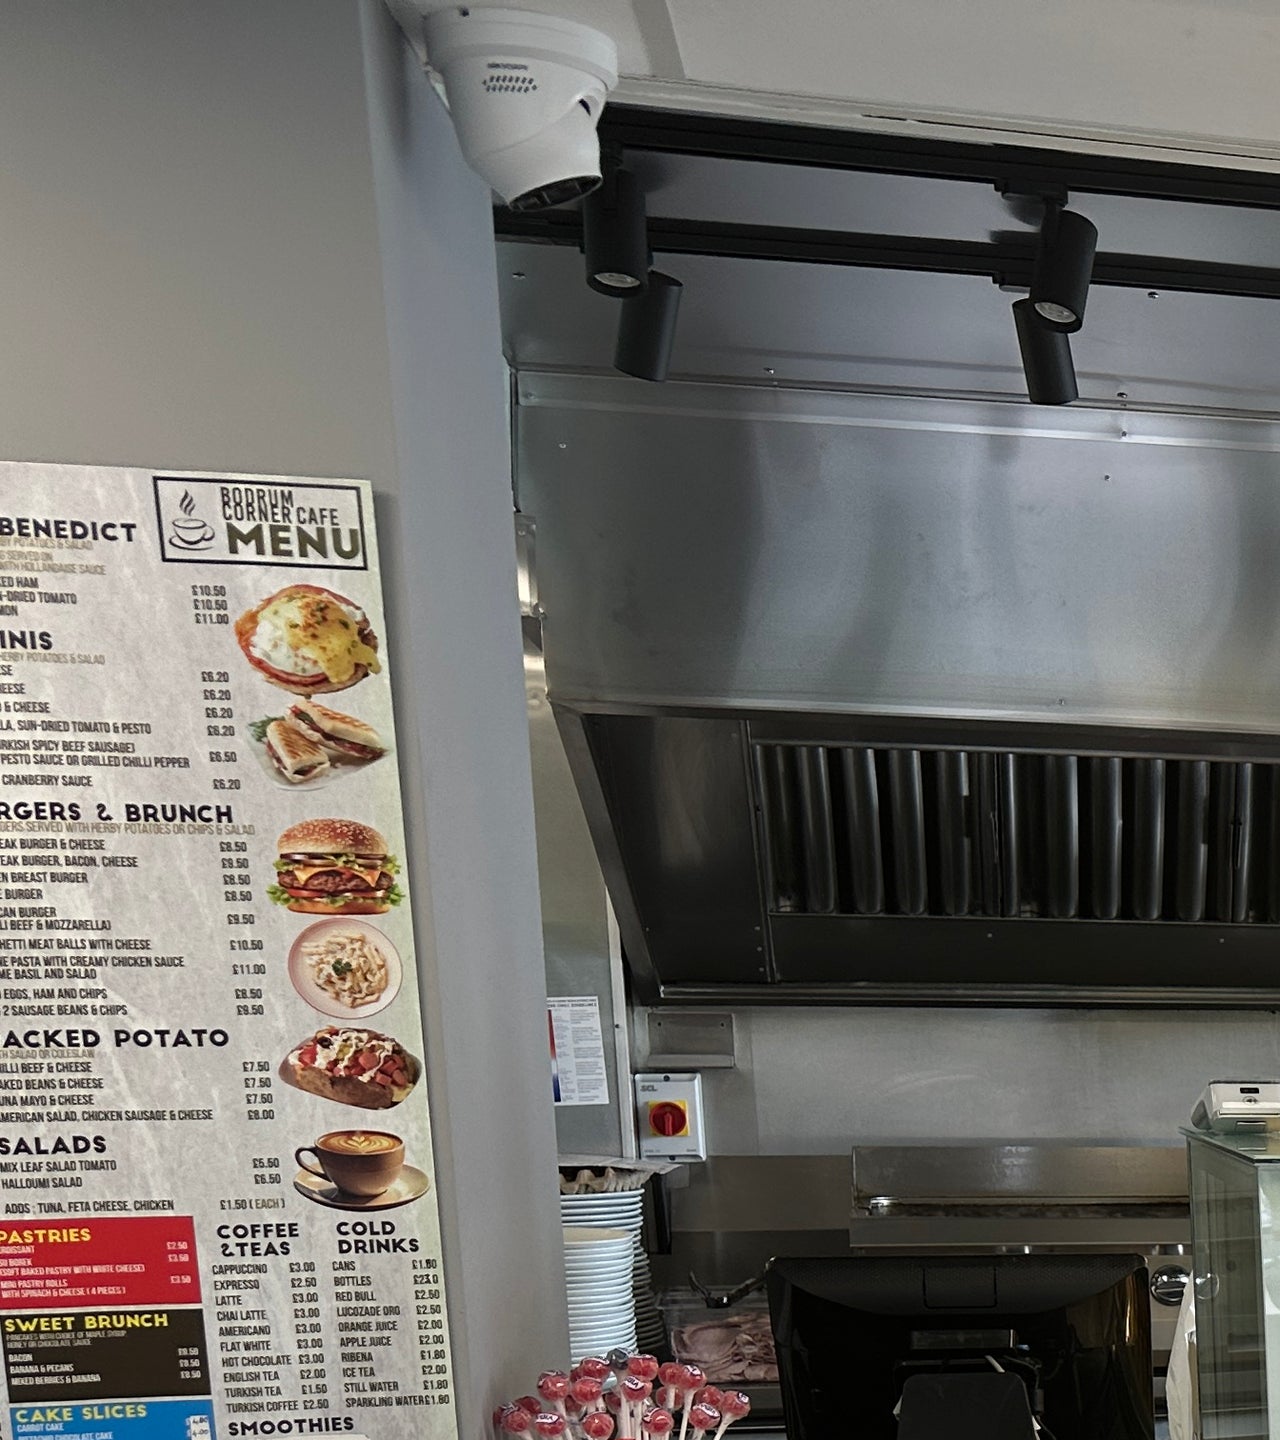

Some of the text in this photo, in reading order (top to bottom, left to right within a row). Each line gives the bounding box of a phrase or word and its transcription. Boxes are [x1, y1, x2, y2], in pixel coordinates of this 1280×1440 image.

[221, 486, 294, 508] BODRUM
[222, 503, 339, 526] CORNER CAFE
[0, 517, 137, 541] BENEDICT
[226, 522, 358, 559] MENU
[17, 578, 226, 596] HAM £10.50
[194, 600, 227, 611] £10.50
[13, 702, 50, 713] CHEESE
[121, 723, 151, 734] PESTO
[154, 757, 190, 768] PEPPER
[2, 775, 92, 786] CRANBERRY SAUCE
[125, 803, 233, 823] BRUNCH
[20, 839, 105, 850] BURGER CHEESE
[11, 872, 88, 884] BREAST BURGER
[28, 940, 263, 951] MEAT BALLS WITH CHEESE £10.50
[11, 956, 185, 967] PASTA CREAMY CHICKEN SAUCE
[114, 1028, 229, 1048] POTATO
[243, 1062, 270, 1072] £7.50
[82, 1110, 274, 1121] CHICKEN SAUSAGE CHEESE £8.00
[0, 1135, 107, 1155] SALADS
[52, 1177, 82, 1188] SALAD
[68, 1200, 174, 1212] FETA CHICKEN
[217, 1223, 299, 1239] COFFEE
[336, 1221, 395, 1236] COLD
[0, 1228, 91, 1244] PASTRIES
[338, 1238, 419, 1254] DRINKS
[212, 1262, 315, 1275] CAPPUCCINO £3.00
[214, 1279, 259, 1290] EXPRESSO
[334, 1276, 372, 1287] BOTTLES
[215, 1292, 318, 1306] LATTE £3.00
[336, 1291, 376, 1302] RED BULL
[5, 1313, 169, 1332] SWEET BRUNCH
[375, 1320, 443, 1331] JUICE £2.00
[219, 1325, 271, 1337] AMERICANO
[220, 1340, 271, 1352] FLAT WHITE
[222, 1353, 324, 1368] HOT CHOCOLATE £3.00
[341, 1352, 373, 1362] RIBENA
[223, 1369, 326, 1383] ENGLISH TEA £2.00
[227, 1400, 299, 1413] TURKISH COFFEE
[346, 1395, 424, 1408] SPARKLING WATER
[16, 1405, 147, 1423] CAKE SLICES
[228, 1416, 354, 1436] SMOOTHIES
